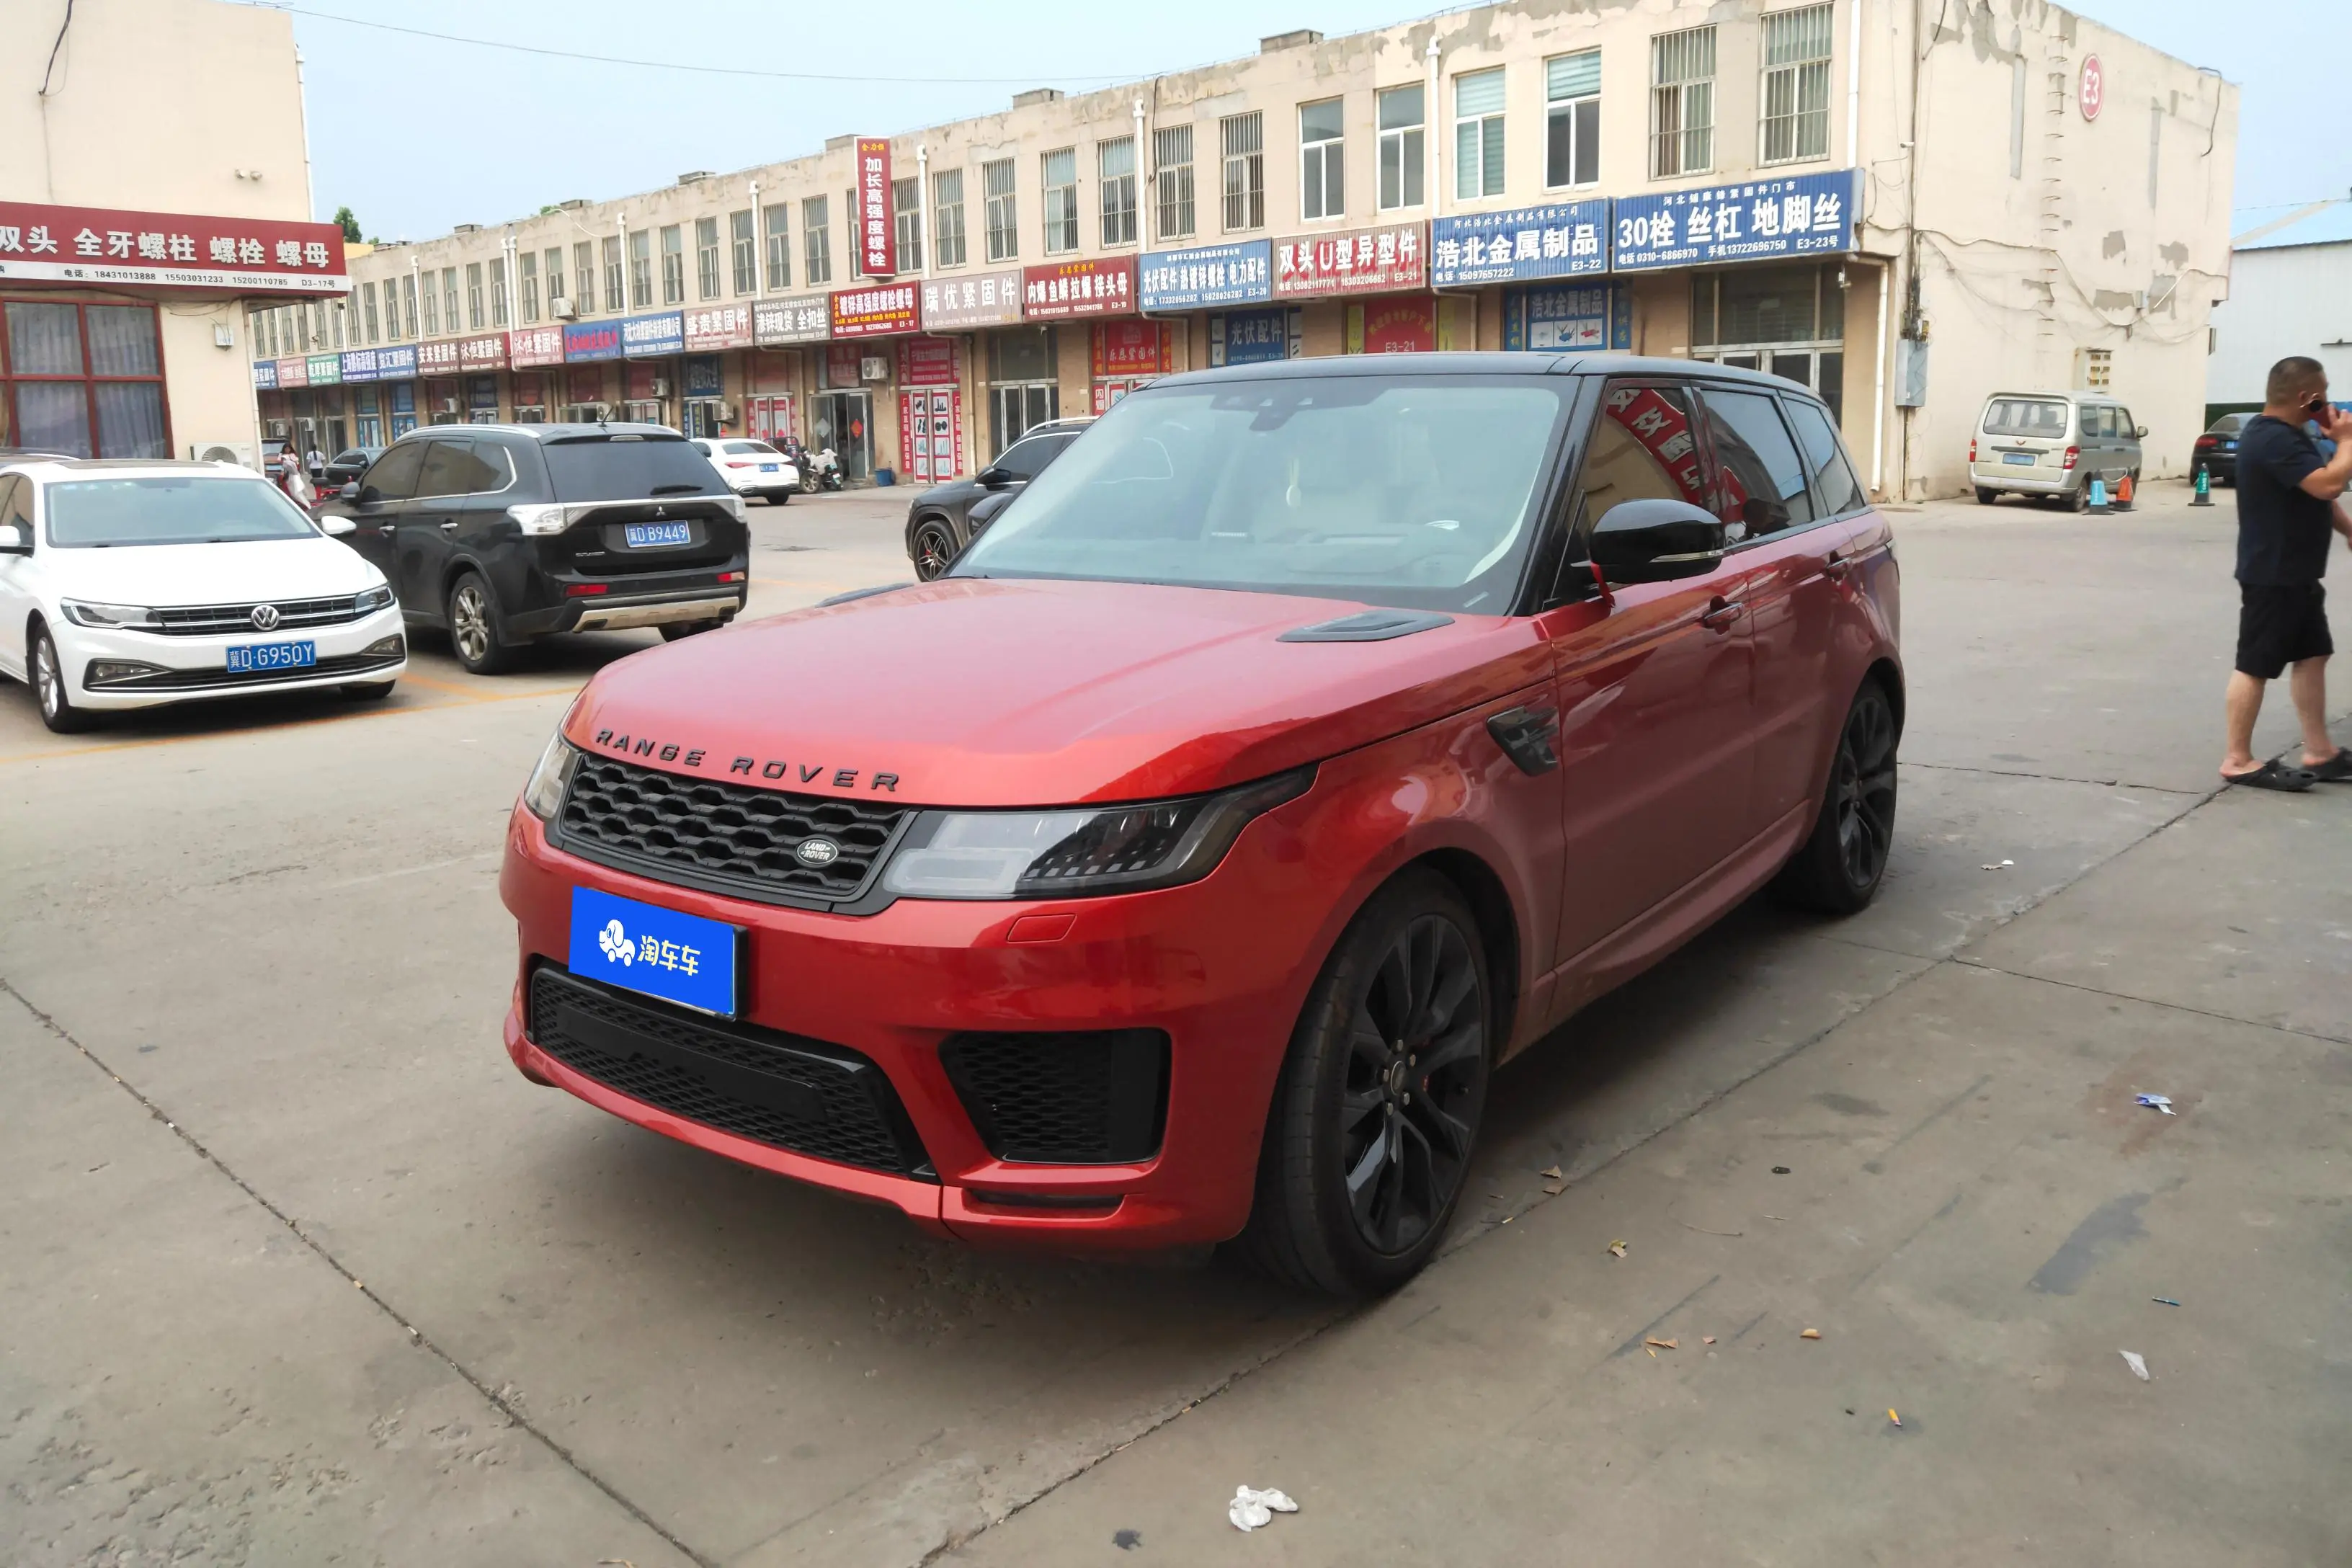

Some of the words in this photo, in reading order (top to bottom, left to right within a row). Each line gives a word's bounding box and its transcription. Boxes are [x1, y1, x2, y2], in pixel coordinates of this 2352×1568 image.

[865, 157, 886, 267] 加长高强度螺栓
[1618, 210, 1675, 249] 30栓
[1688, 203, 1742, 243] 丝杠
[1752, 192, 1842, 236] 地脚丝
[0, 226, 58, 254] 双头
[74, 228, 197, 262] 全牙螺柱
[210, 236, 265, 264] 螺栓
[276, 240, 329, 268] 螺母
[1279, 228, 1417, 273] 双头U型异型件
[1436, 223, 1598, 269] 浩北金属制品
[1619, 253, 1634, 264] 电话
[1637, 248, 1698, 262] 0310-6866970
[1797, 236, 1838, 249] E3-23号
[94, 271, 156, 280] 18431013888
[165, 274, 223, 283] 15503031233
[233, 277, 288, 285] 15200110785
[1144, 266, 1177, 293] 光伏配件
[1180, 262, 1225, 290] 热镀锌螺栓
[1229, 257, 1266, 285] 电力配件
[1279, 282, 1291, 291] 电话
[1394, 272, 1417, 282] E3-21
[1435, 271, 1453, 282] 电话
[1458, 267, 1514, 280] 15097657222
[1572, 259, 1601, 271] E3-22
[925, 277, 1015, 312] 瑞优紧固件
[1532, 289, 1603, 318] 浩北金属制品
[1231, 317, 1282, 345] 光伏配件
[1386, 341, 1415, 352] E3-21
[596, 728, 706, 767] RANGE
[730, 756, 899, 791] ROVER
[803, 850, 830, 860] ROVER
